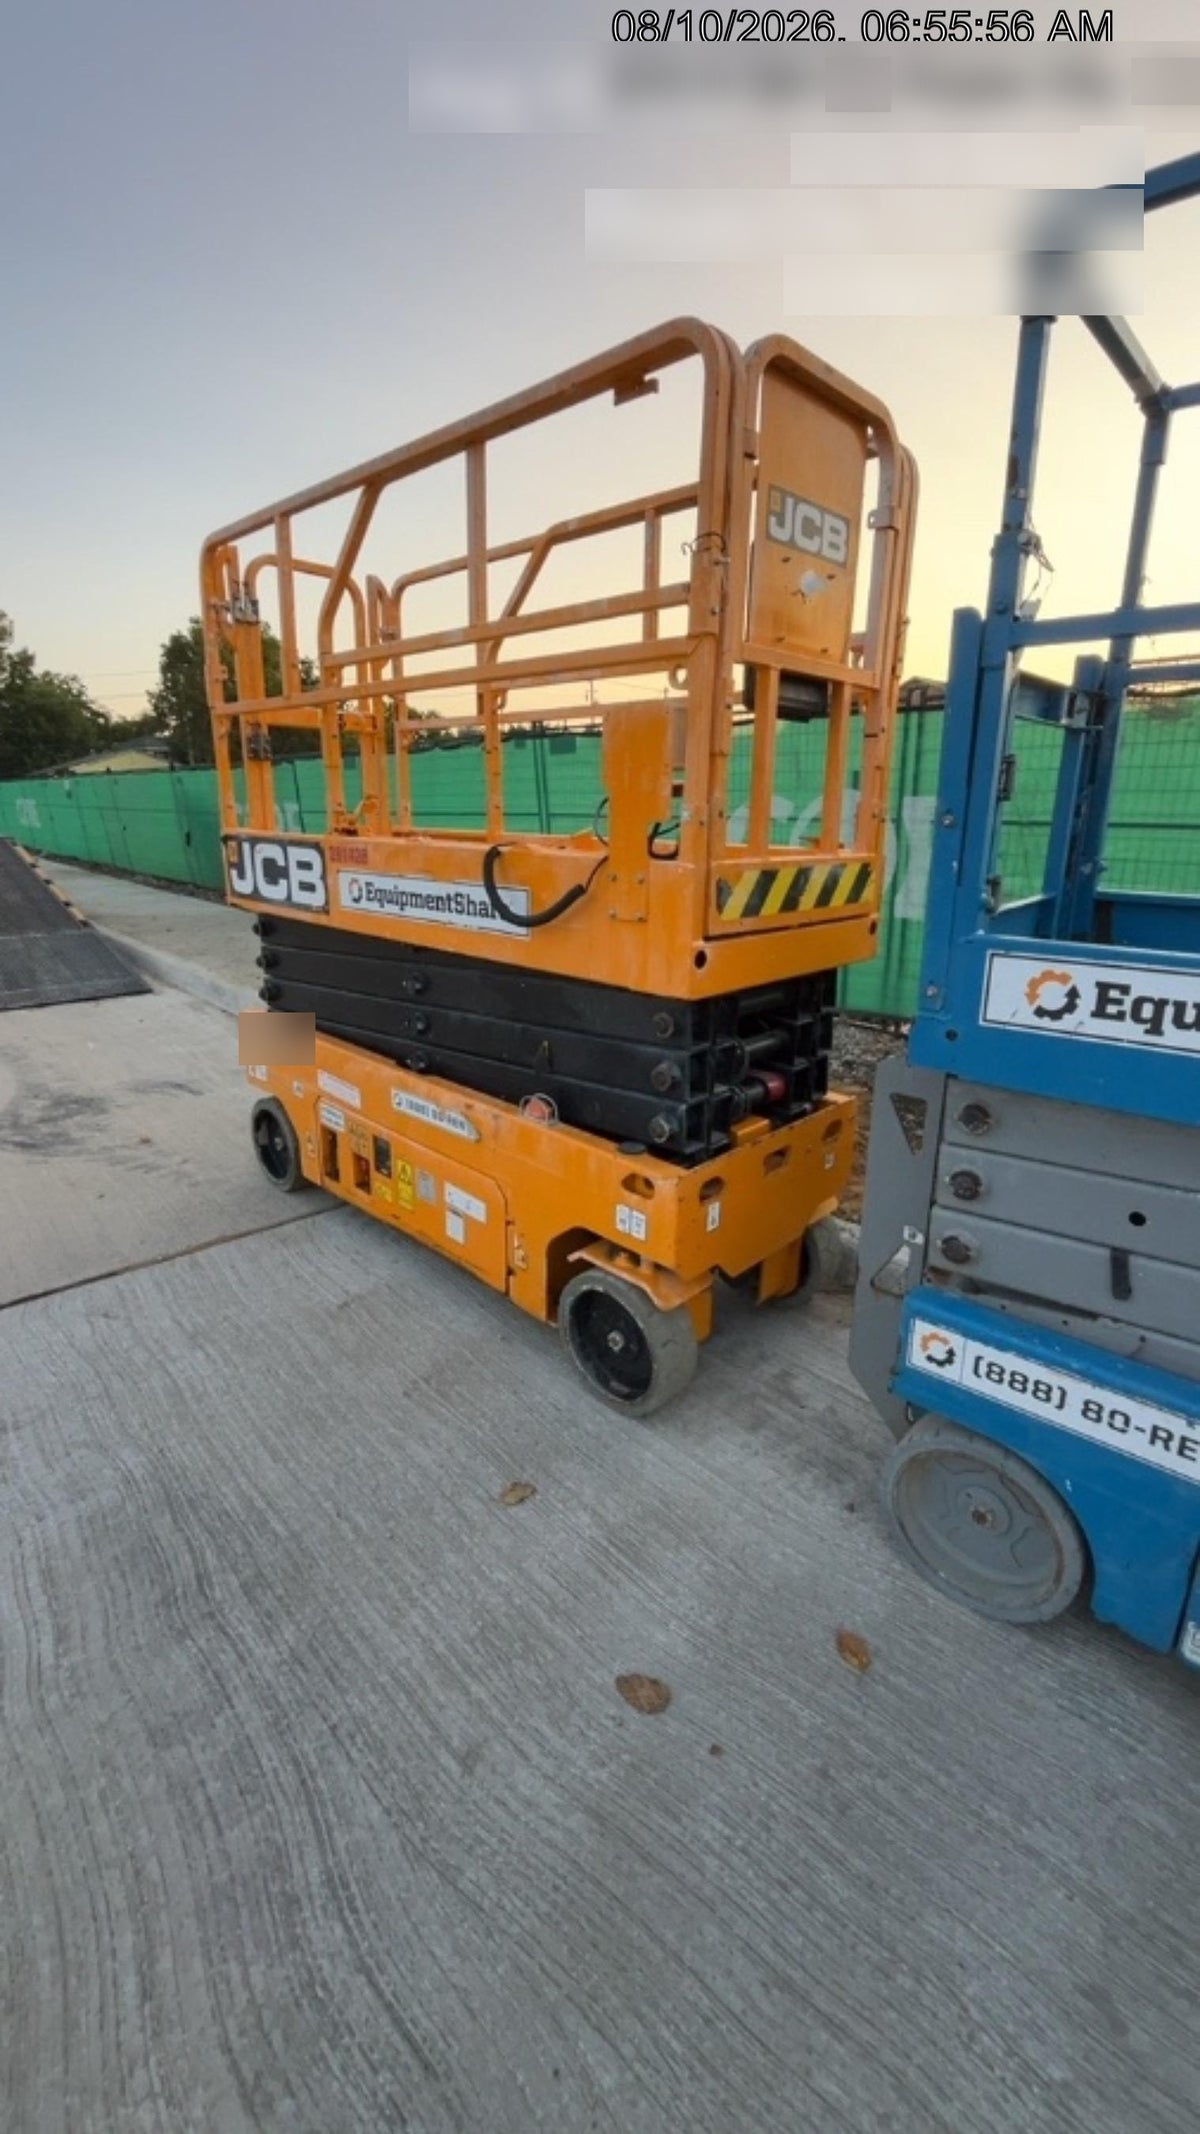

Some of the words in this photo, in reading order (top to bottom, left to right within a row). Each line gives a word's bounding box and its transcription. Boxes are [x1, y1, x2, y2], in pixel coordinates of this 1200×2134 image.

[769, 495, 848, 563] JCB
[230, 841, 326, 906] JCB
[364, 881, 498, 919] EquipmentShar
[1090, 981, 1200, 1036] Equ
[973, 1355, 1067, 1410] (888)
[1080, 1398, 1199, 1462] 80-RE
